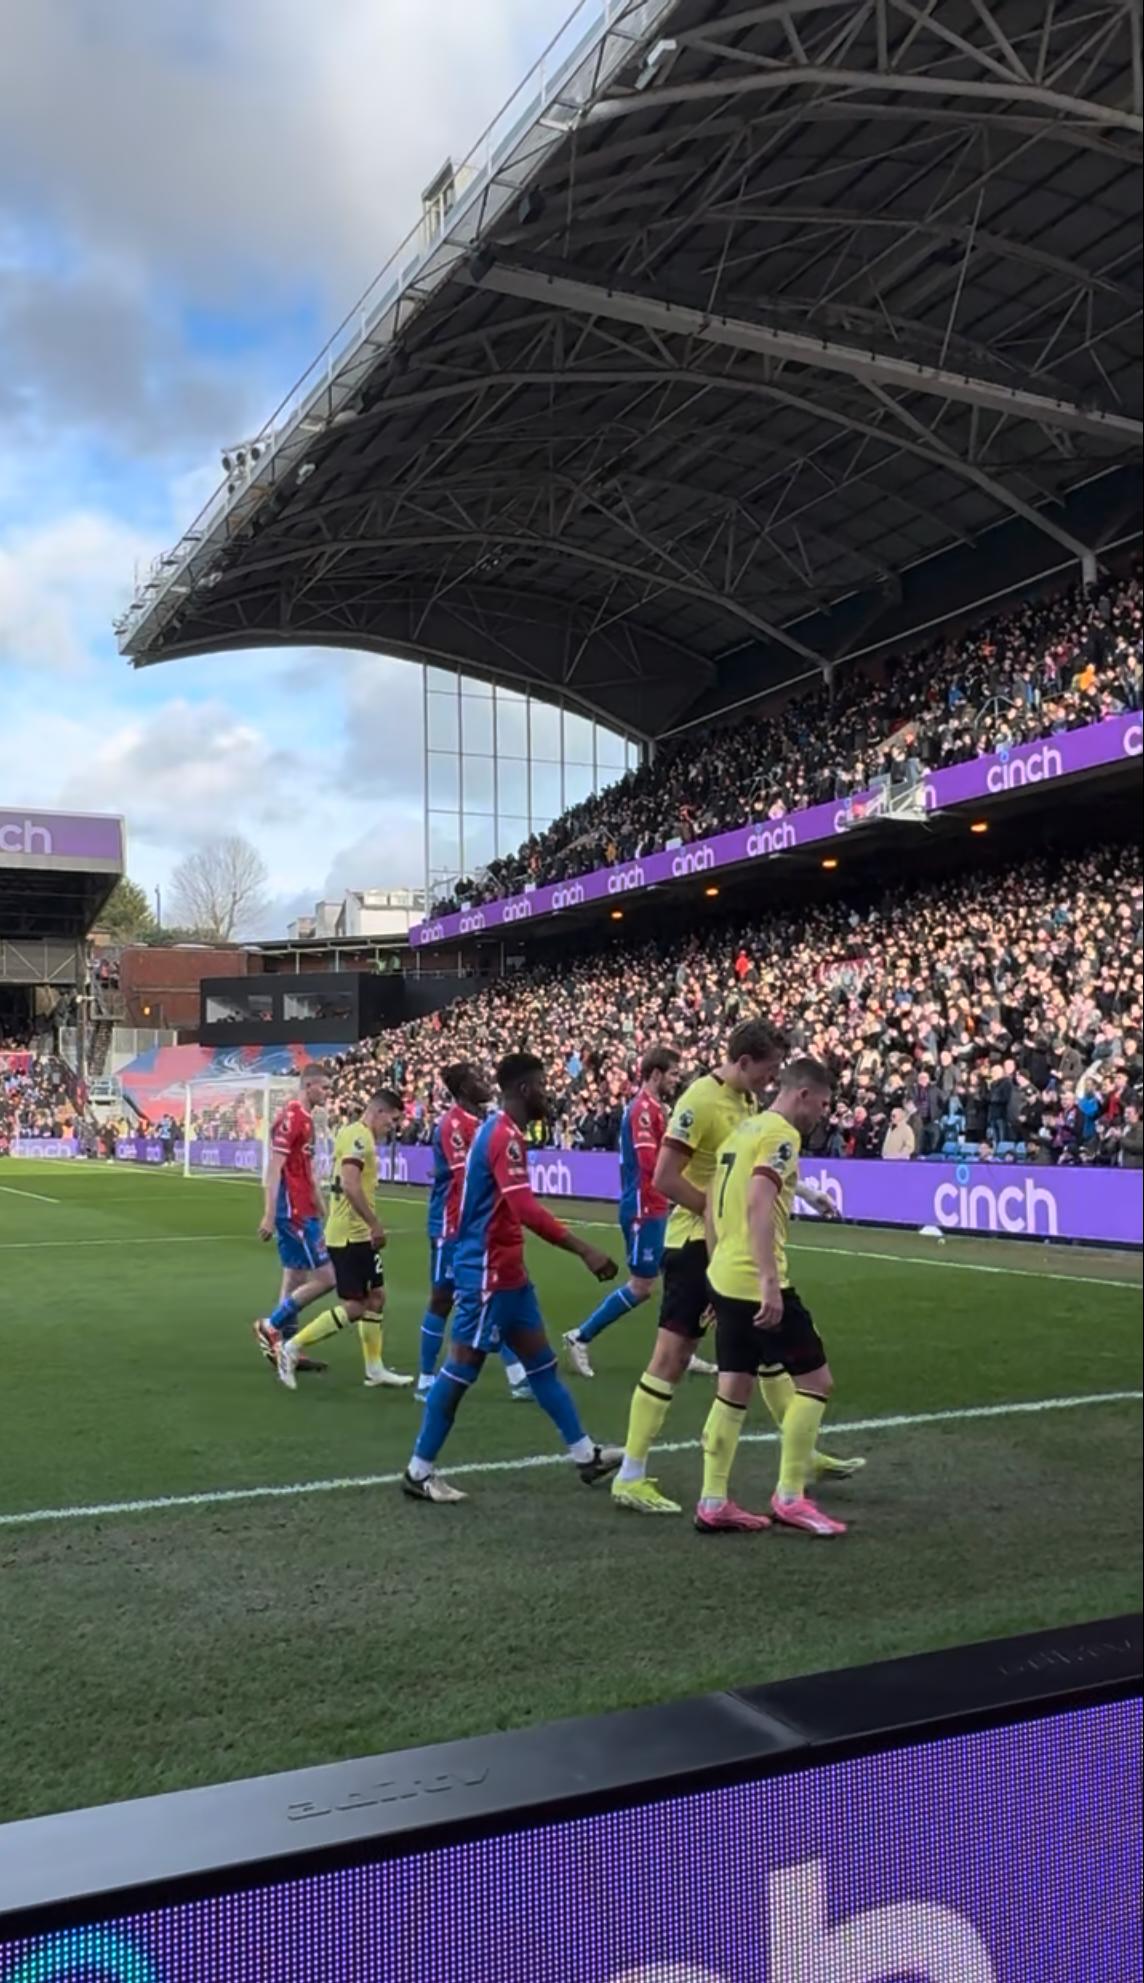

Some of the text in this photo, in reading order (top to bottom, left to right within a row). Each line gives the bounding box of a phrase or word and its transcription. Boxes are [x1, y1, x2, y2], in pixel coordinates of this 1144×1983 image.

[987, 746, 1062, 794] cinch
[746, 822, 796, 857] cinch
[672, 845, 715, 877] cinch
[552, 881, 584, 909] cinch
[608, 864, 645, 894] cinch
[503, 899, 532, 923] cinch
[527, 1151, 572, 1194] inch
[719, 1152, 737, 1219] 7
[934, 1163, 1058, 1236] cinch
[374, 1254, 383, 1274] 2
